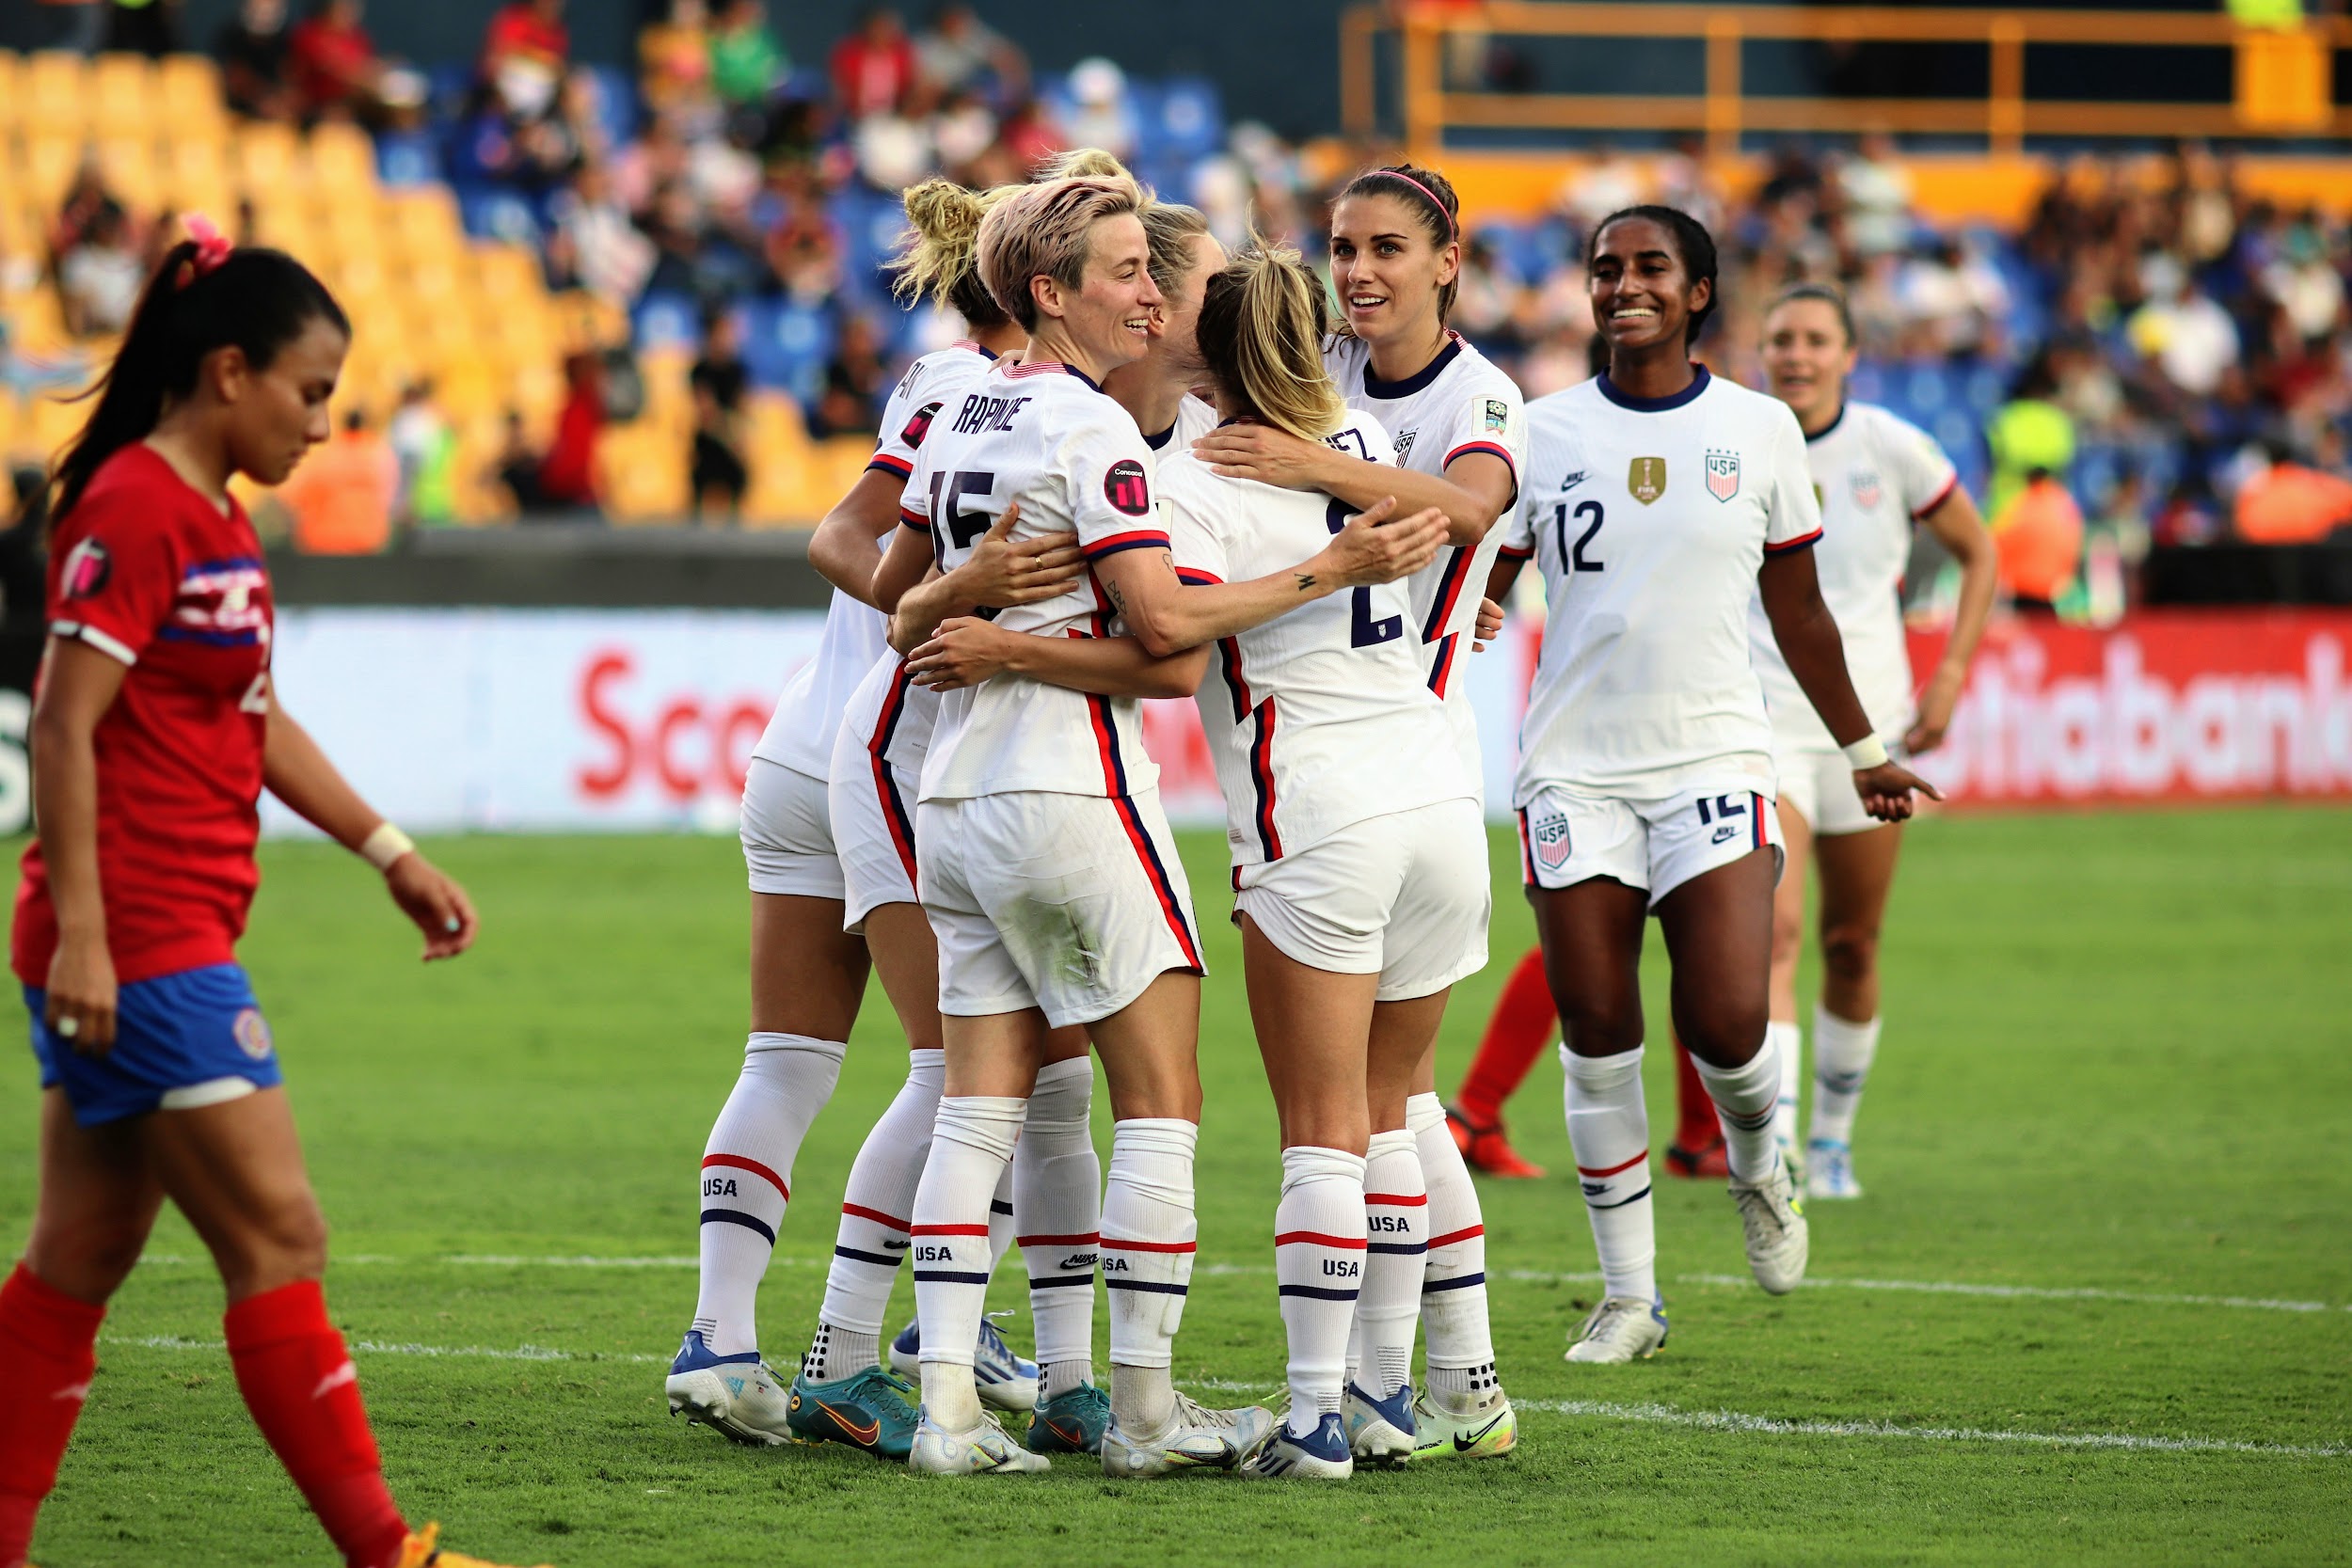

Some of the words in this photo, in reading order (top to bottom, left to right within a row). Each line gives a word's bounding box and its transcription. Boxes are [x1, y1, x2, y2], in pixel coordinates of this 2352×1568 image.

[1709, 459, 1737, 475] USA
[1555, 500, 1604, 576] 12
[1539, 825, 1565, 844] USA
[704, 1178, 738, 1197] USA
[1368, 1216, 1409, 1232] USA
[916, 1246, 952, 1261] USA
[1101, 1258, 1128, 1272] USA
[1323, 1259, 1359, 1276] USA
